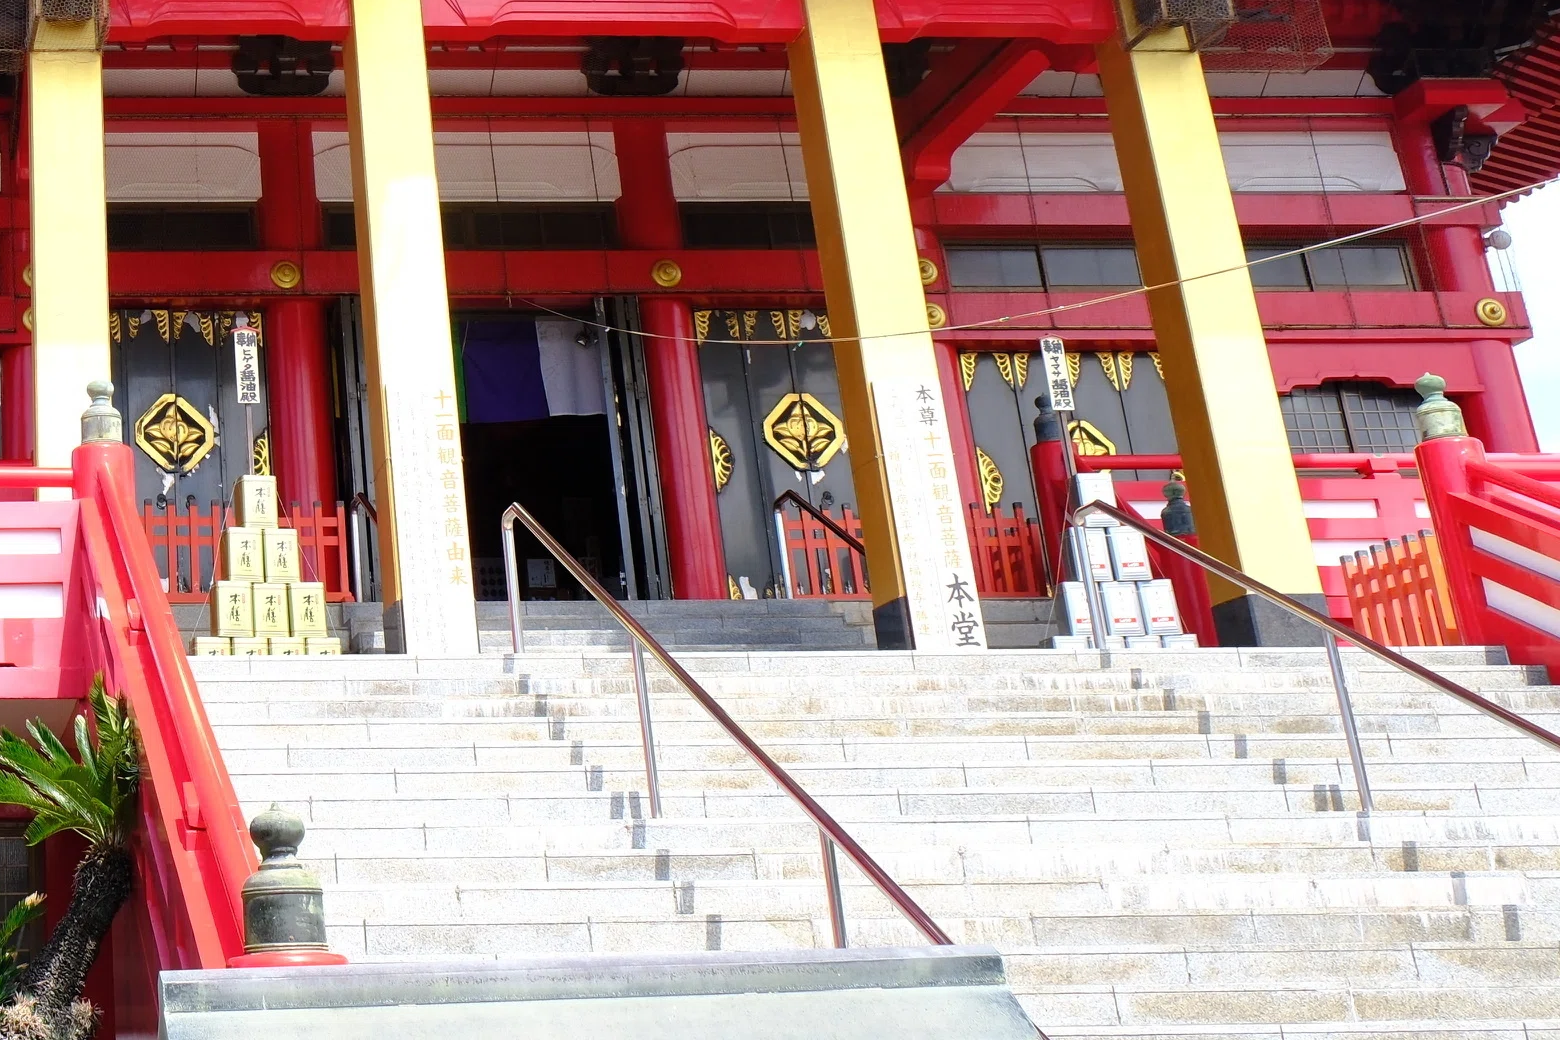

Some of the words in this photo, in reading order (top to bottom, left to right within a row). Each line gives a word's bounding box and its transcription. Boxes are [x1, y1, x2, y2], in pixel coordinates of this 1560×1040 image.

[236, 332, 257, 347] 奉納
[1043, 339, 1063, 355] 奉納
[433, 388, 469, 586] 十一面観音菩薩由来
